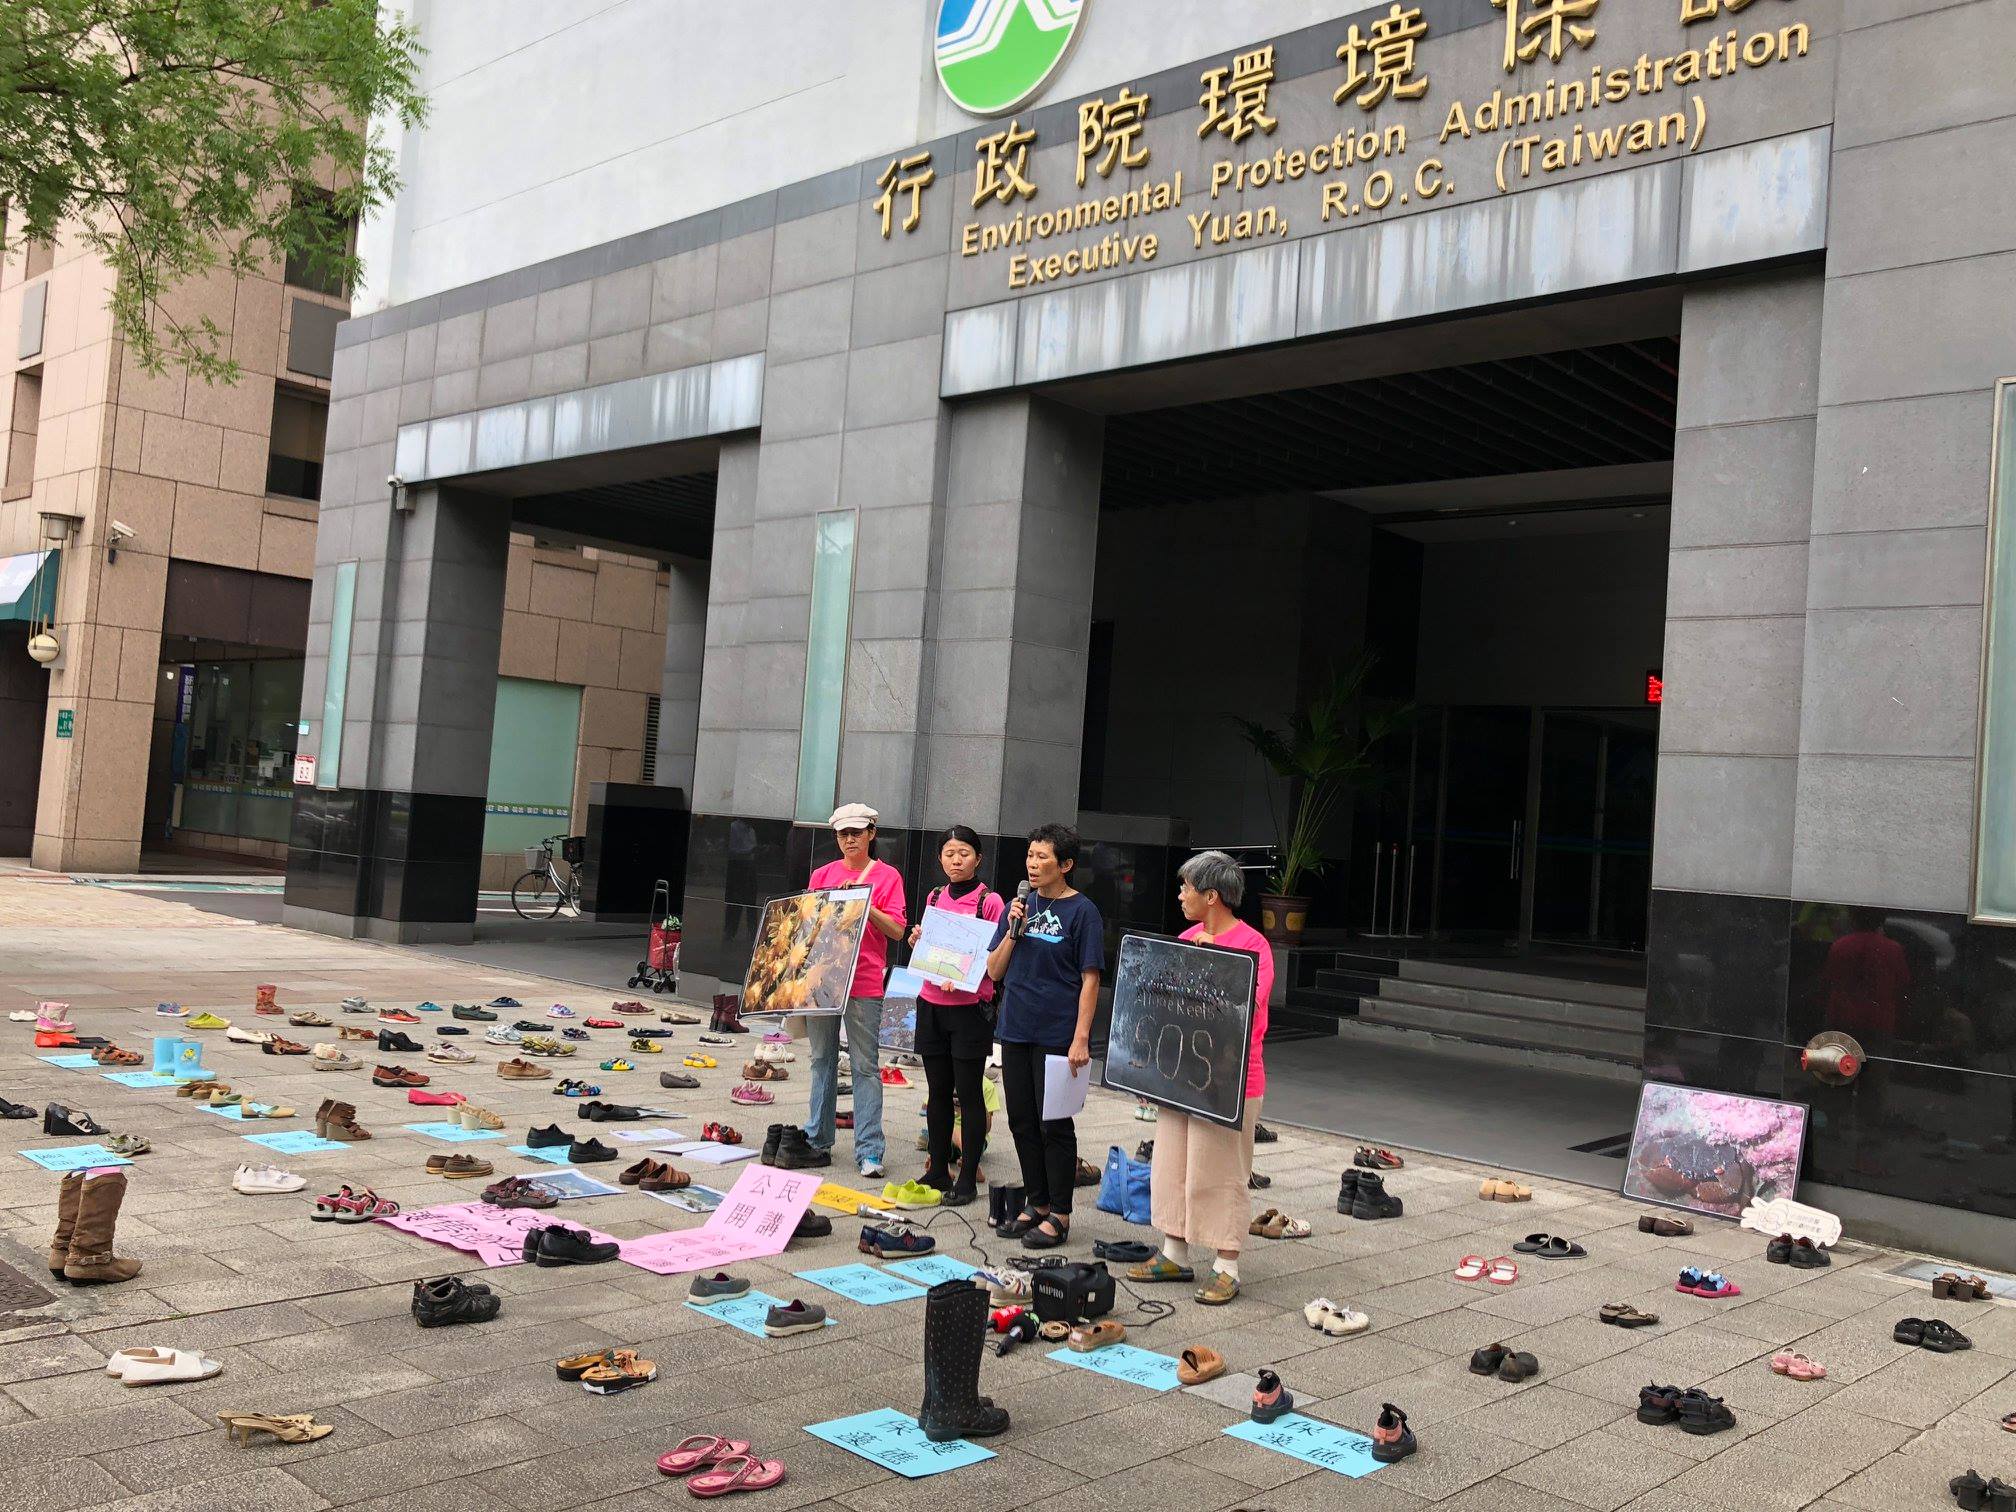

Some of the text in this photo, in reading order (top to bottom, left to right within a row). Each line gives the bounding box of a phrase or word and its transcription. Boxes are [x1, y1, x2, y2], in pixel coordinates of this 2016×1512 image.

[872, 0, 1756, 238] 行政院環境保
[961, 22, 1811, 257] Environmental Protection Administration
[1008, 96, 1707, 289] Executive Yuan, R.O.C. (Taiwan)
[1128, 1015, 1213, 1091] SOS
[724, 1202, 786, 1238] 開講
[748, 1174, 801, 1203] 公民
[1039, 1284, 1064, 1300] MIPRO
